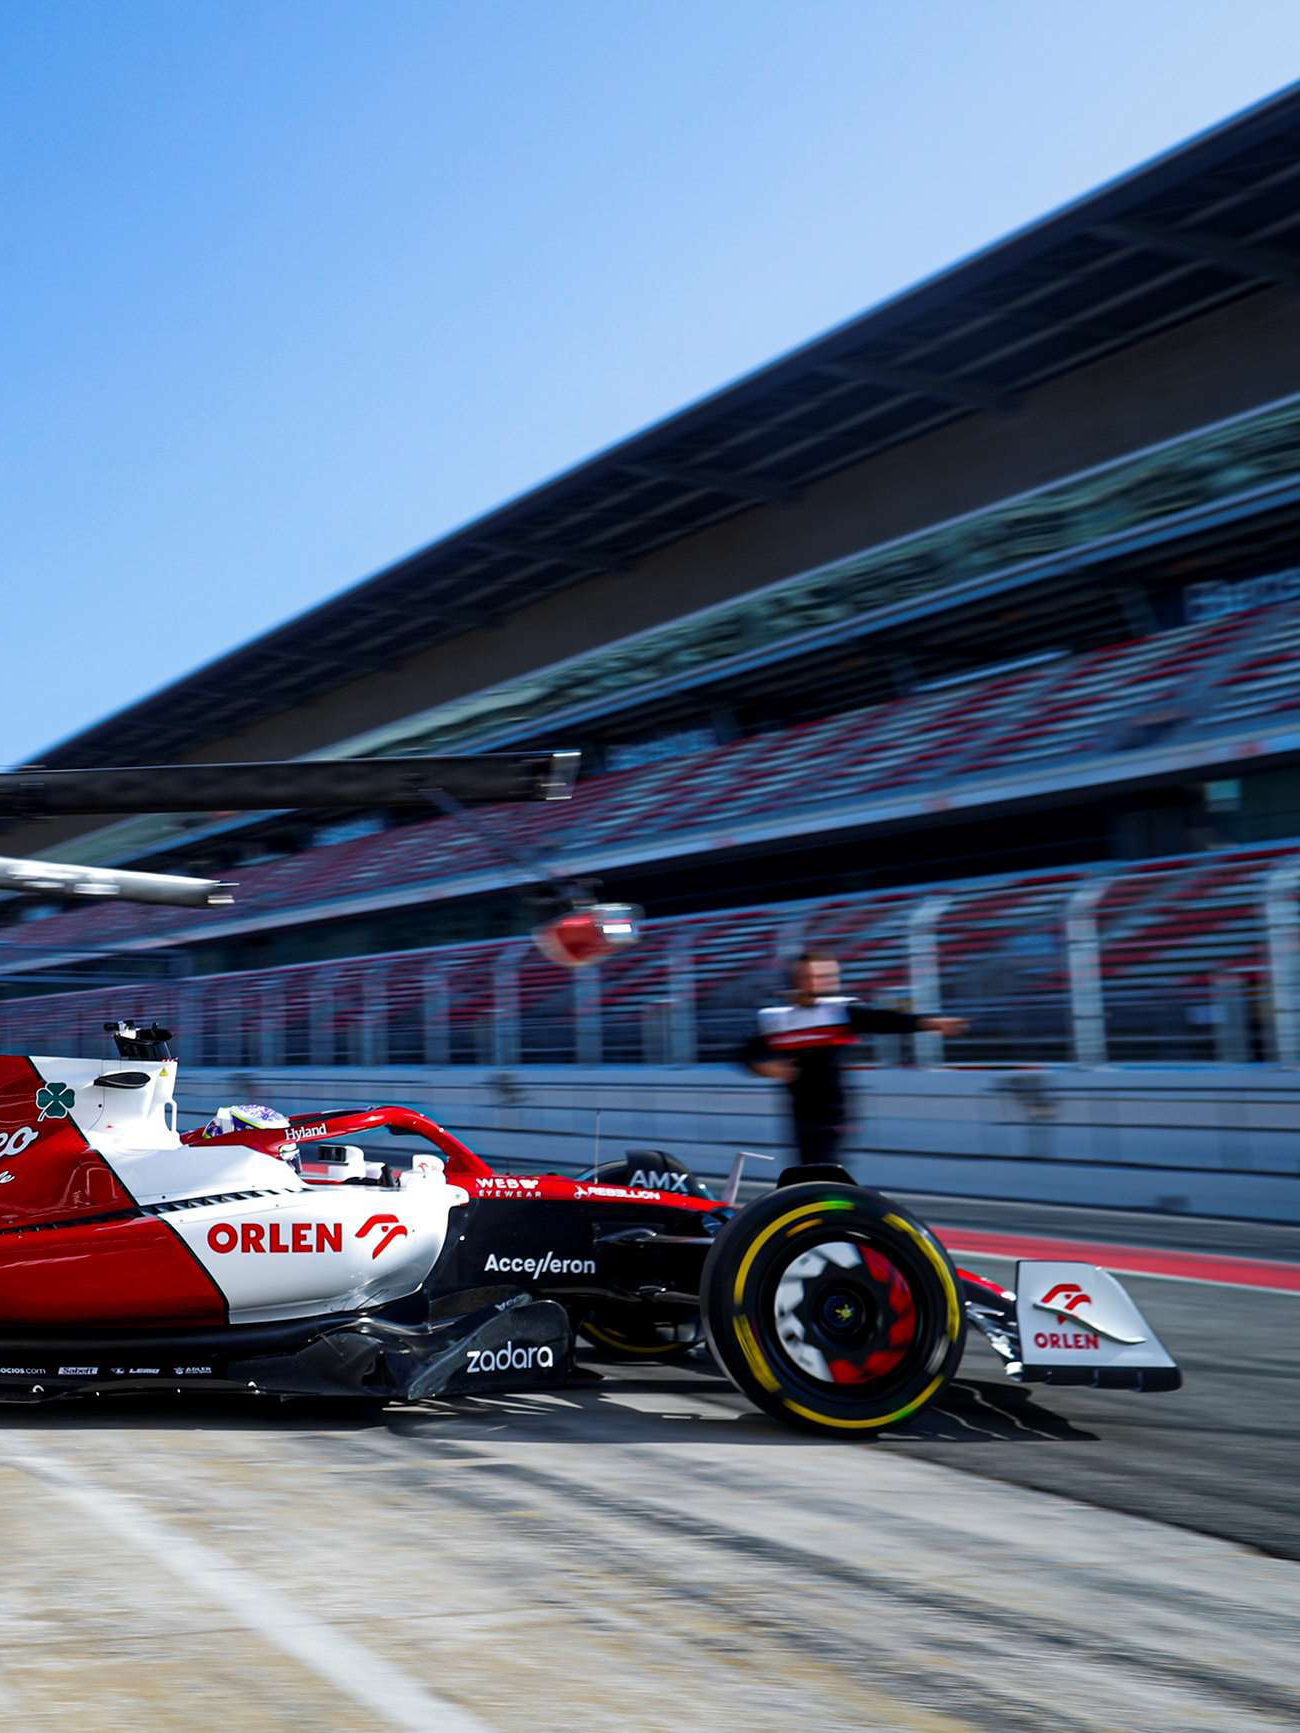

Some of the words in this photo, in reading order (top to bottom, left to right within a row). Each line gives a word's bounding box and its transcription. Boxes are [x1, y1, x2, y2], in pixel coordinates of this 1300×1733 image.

[284, 1123, 327, 1142] Hyland
[629, 1169, 689, 1192] AMX
[478, 1189, 542, 1198] EYEWEAR
[586, 1186, 661, 1200] REBELLION
[207, 1223, 342, 1254] ORLEN
[1034, 1332, 1100, 1350] ORLEN
[466, 1340, 554, 1373] zadara
